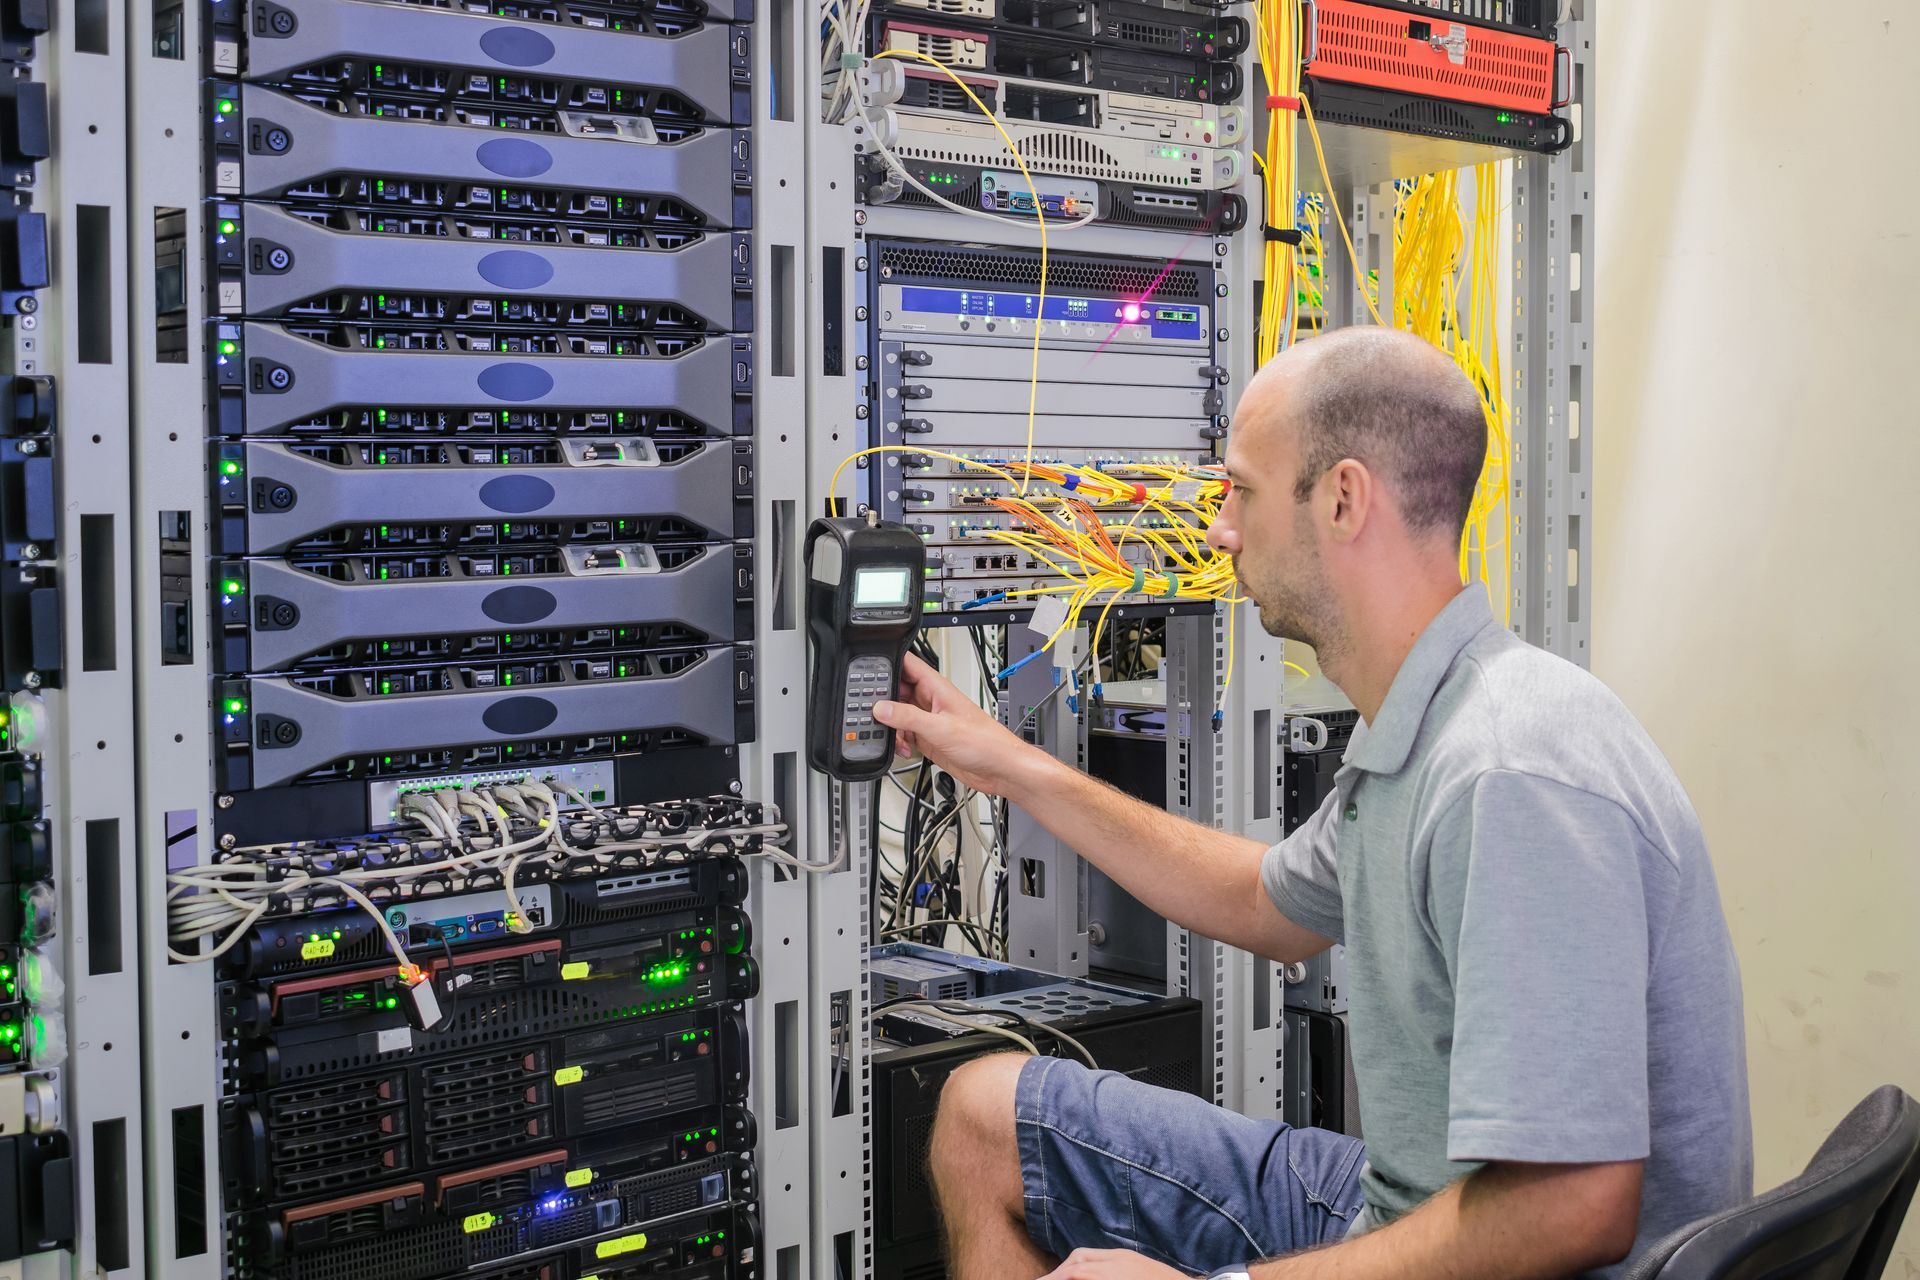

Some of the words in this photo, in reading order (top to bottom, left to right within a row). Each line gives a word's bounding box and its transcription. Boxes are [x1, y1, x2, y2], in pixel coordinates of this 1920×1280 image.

[219, 48, 230, 61] 2
[221, 170, 233, 182] 3
[224, 289, 235, 303] 4
